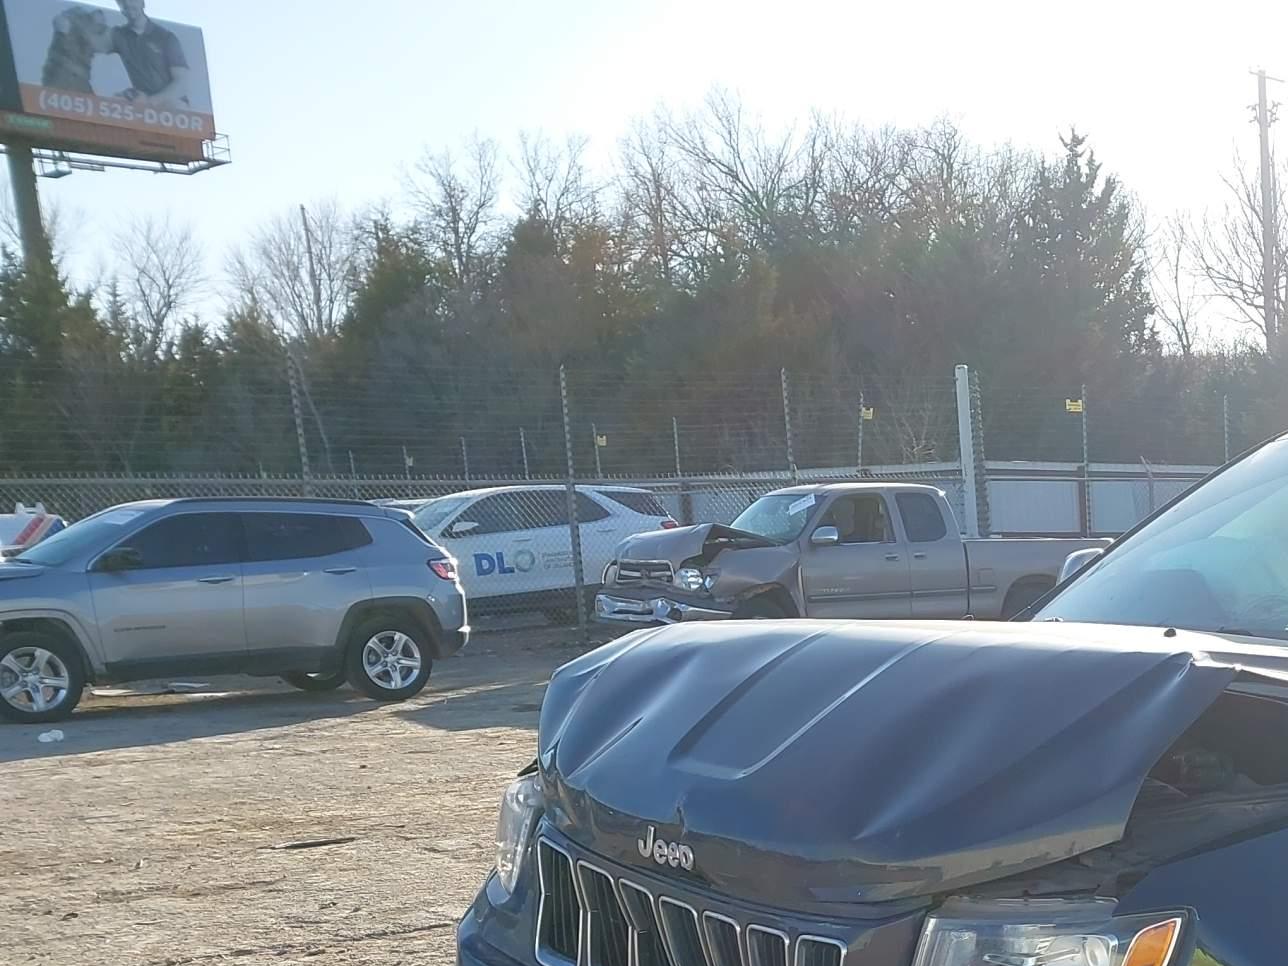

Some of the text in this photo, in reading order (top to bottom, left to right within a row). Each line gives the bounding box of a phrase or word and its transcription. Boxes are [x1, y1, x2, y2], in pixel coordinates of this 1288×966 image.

[39, 90, 204, 131] (405) 525-DOOR
[473, 549, 536, 577] DLO
[637, 824, 695, 871] Jeep
